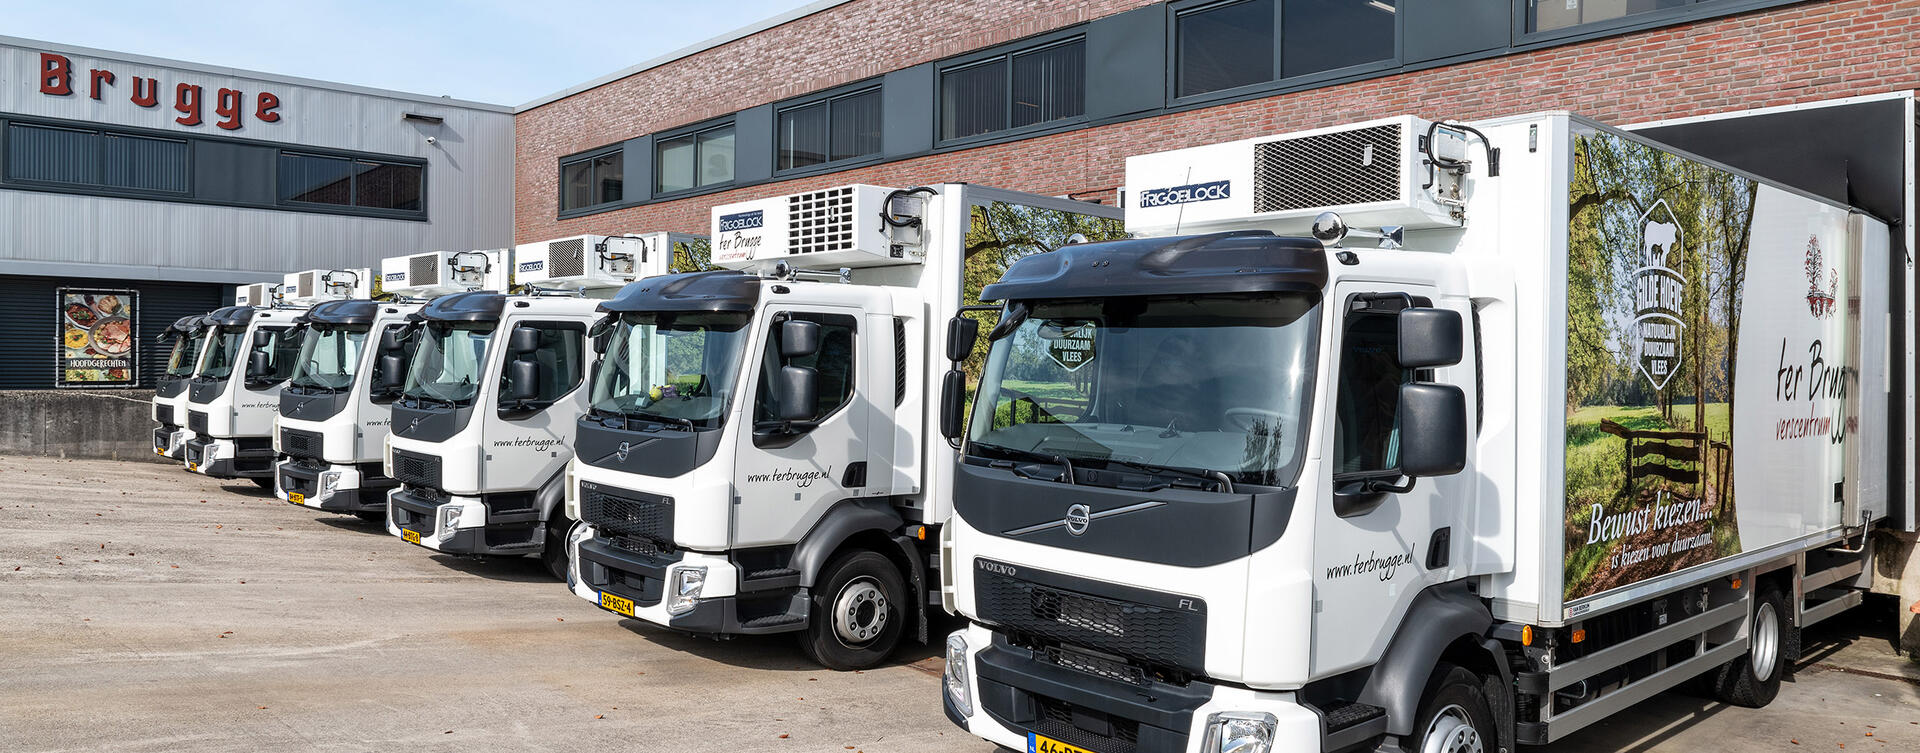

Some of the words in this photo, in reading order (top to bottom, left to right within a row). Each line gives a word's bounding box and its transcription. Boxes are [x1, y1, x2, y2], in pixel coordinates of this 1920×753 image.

[40, 52, 281, 130] Brugge
[1140, 184, 1229, 207] FRIGOBLOCK
[719, 233, 731, 250] ter
[734, 231, 762, 260] Brugge
[1637, 274, 1659, 312] GILDE
[1660, 275, 1683, 317] HOEVE
[1053, 339, 1091, 350] DUURZAAM
[1645, 341, 1675, 357] DUURZAAM
[70, 359, 126, 368] HOOFDGERECHTEN
[1062, 351, 1082, 362] VLEES
[1651, 359, 1668, 375] VLEES
[1776, 337, 1803, 401] ter
[1776, 402, 1830, 440] verscentrum
[493, 435, 565, 452] www.terbrugge.nl
[747, 464, 831, 488] www.terbrugge.nl
[1067, 515, 1088, 524] VOLVO
[1586, 503, 1651, 545] Bewust
[1653, 490, 1713, 531] kiezen...
[1611, 549, 1619, 569] is
[1621, 543, 1649, 567] kiezen
[1651, 542, 1671, 559] voor
[1671, 526, 1715, 554] duurzaam!
[977, 560, 1016, 576] VOLVO
[1326, 542, 1415, 582] www.terbrugge.nl
[603, 595, 632, 613] 59-BSZ-4
[1178, 599, 1198, 611] FL
